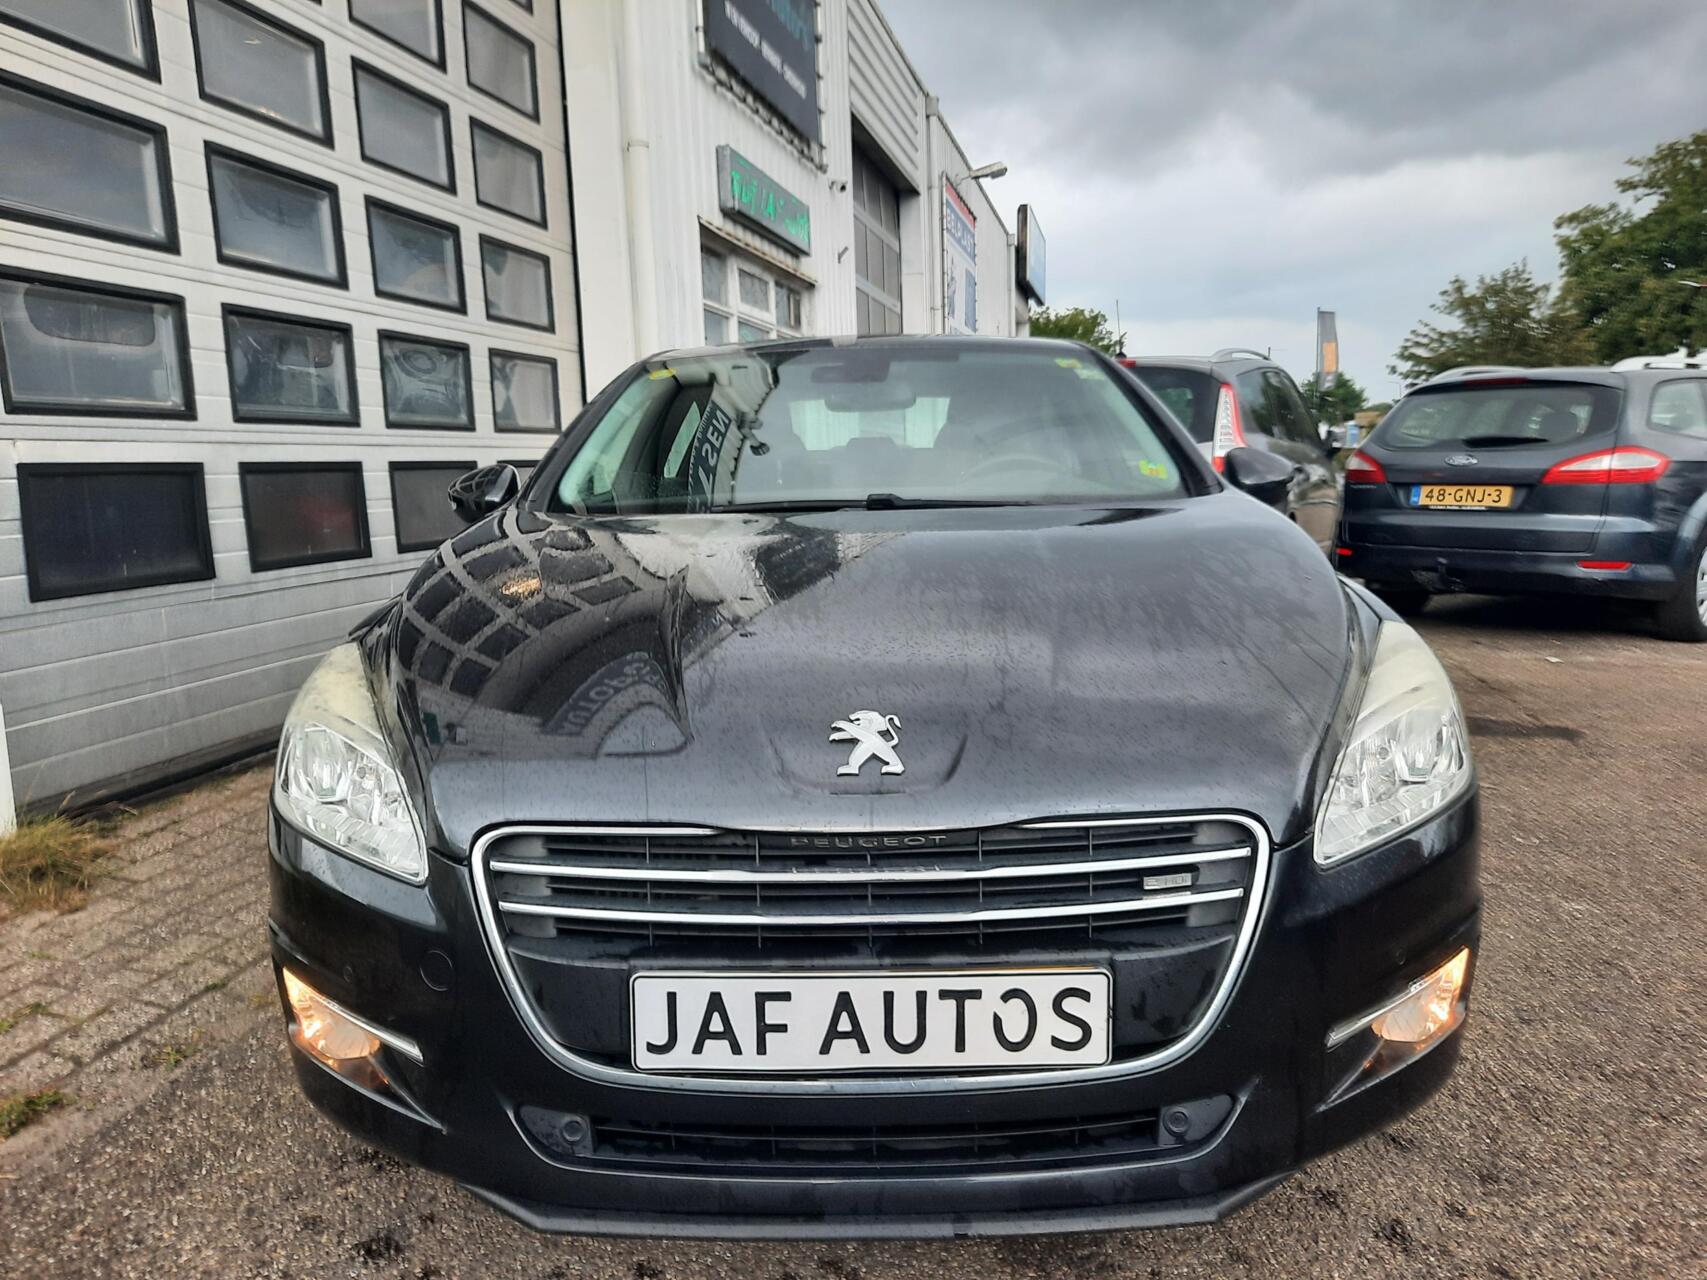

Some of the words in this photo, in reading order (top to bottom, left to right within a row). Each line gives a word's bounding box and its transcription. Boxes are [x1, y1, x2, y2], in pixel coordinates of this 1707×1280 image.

[1425, 488, 1502, 503] 48-GNJ-3
[791, 835, 947, 848] PEUGEOT
[646, 991, 792, 1056] JAF
[818, 987, 1093, 1055] AUTOS
